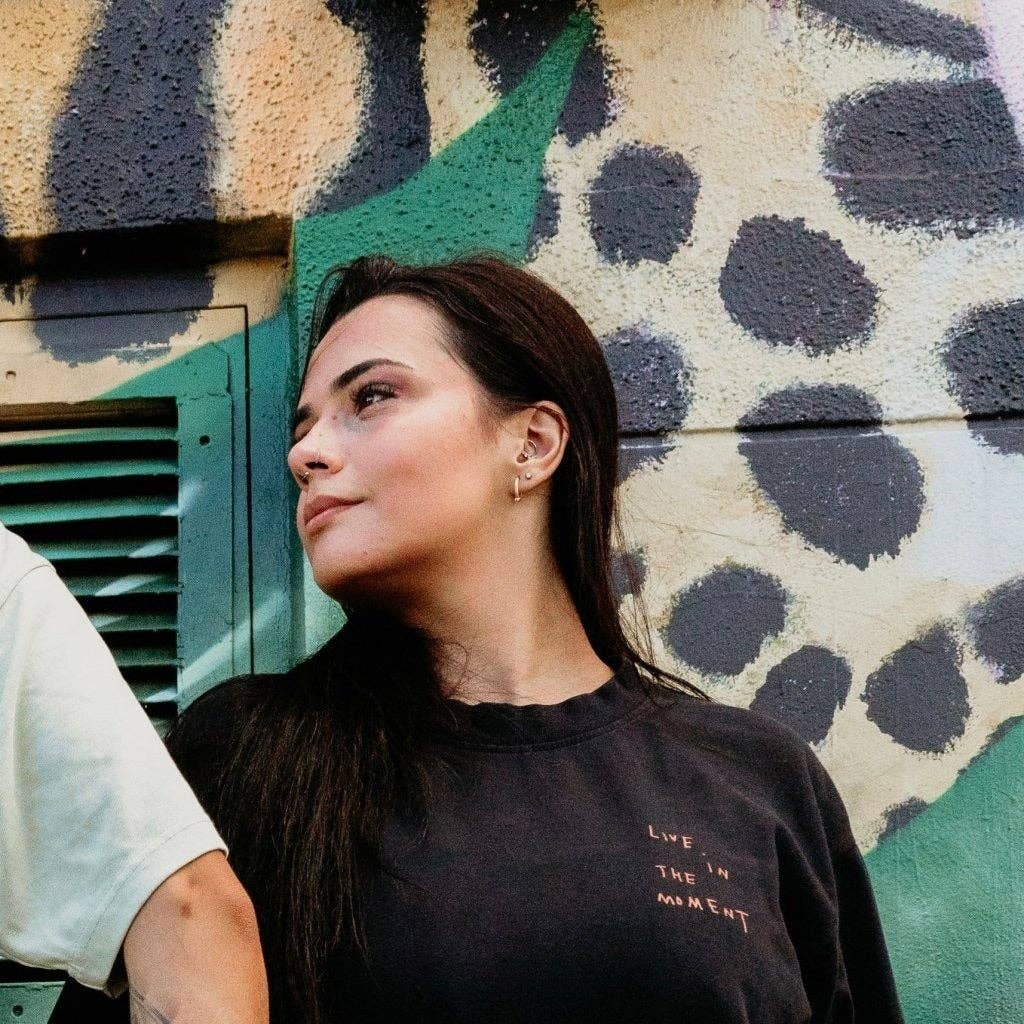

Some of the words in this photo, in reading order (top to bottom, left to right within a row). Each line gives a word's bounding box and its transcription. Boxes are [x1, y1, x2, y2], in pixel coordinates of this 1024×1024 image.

[648, 824, 693, 849] LIVE
[655, 864, 696, 885] THE
[707, 862, 729, 880] IN
[657, 892, 750, 934] MOMENT
